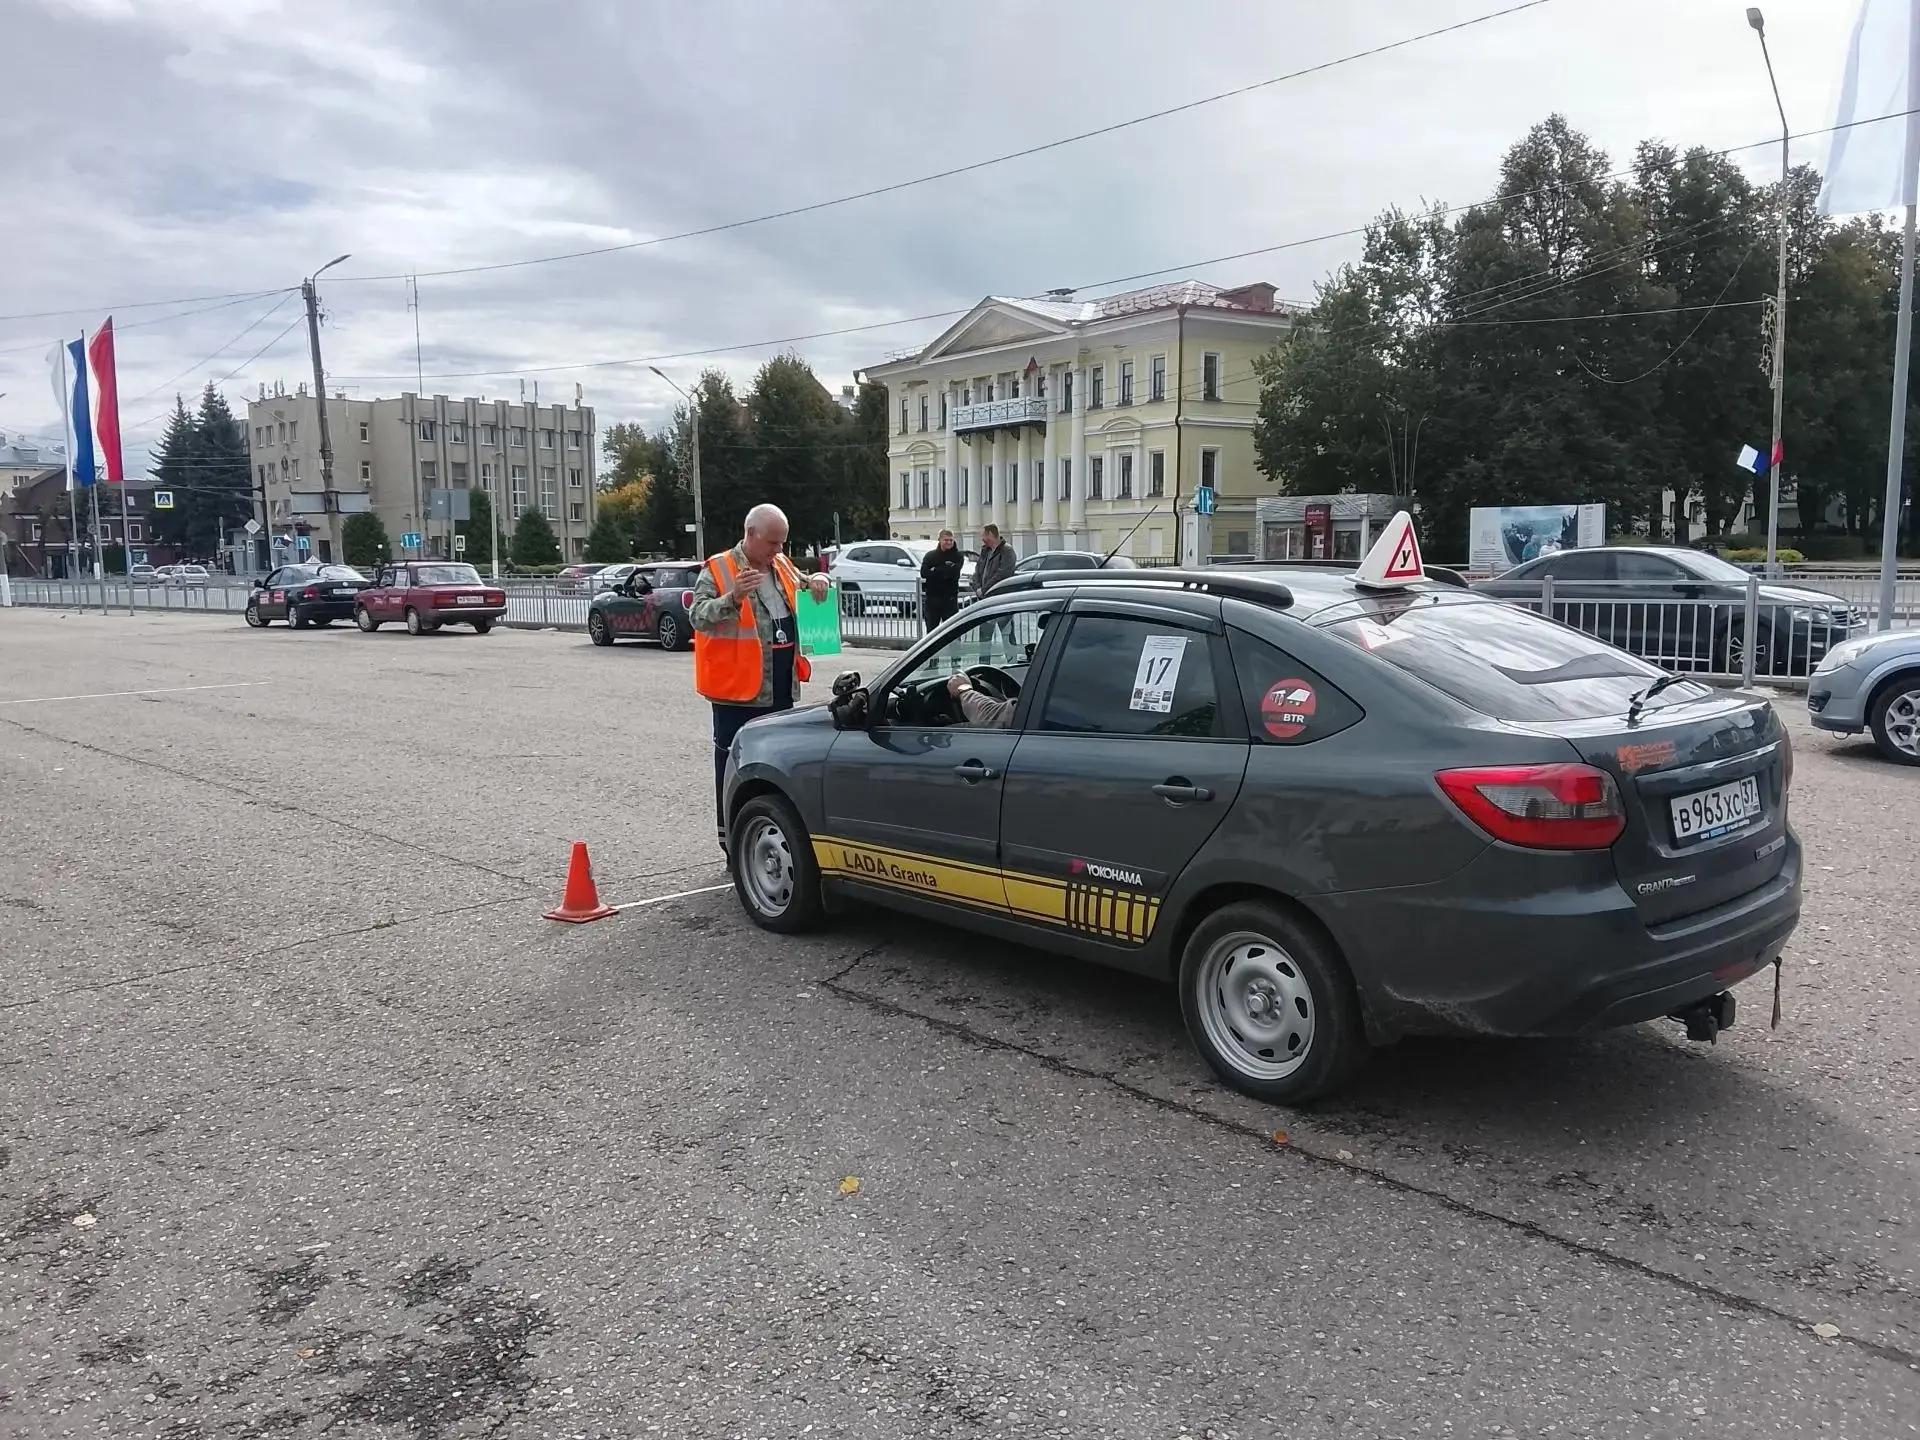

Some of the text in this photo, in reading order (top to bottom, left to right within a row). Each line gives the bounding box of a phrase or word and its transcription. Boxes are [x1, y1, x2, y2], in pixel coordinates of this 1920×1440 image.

[1400, 550, 1412, 568] У
[1145, 657, 1173, 686] 17
[1742, 779, 1754, 805] 37
[842, 850, 938, 888] LADA Granta
[1086, 863, 1143, 886] YOKOHAMA
[1637, 877, 1674, 895] GRANTA
